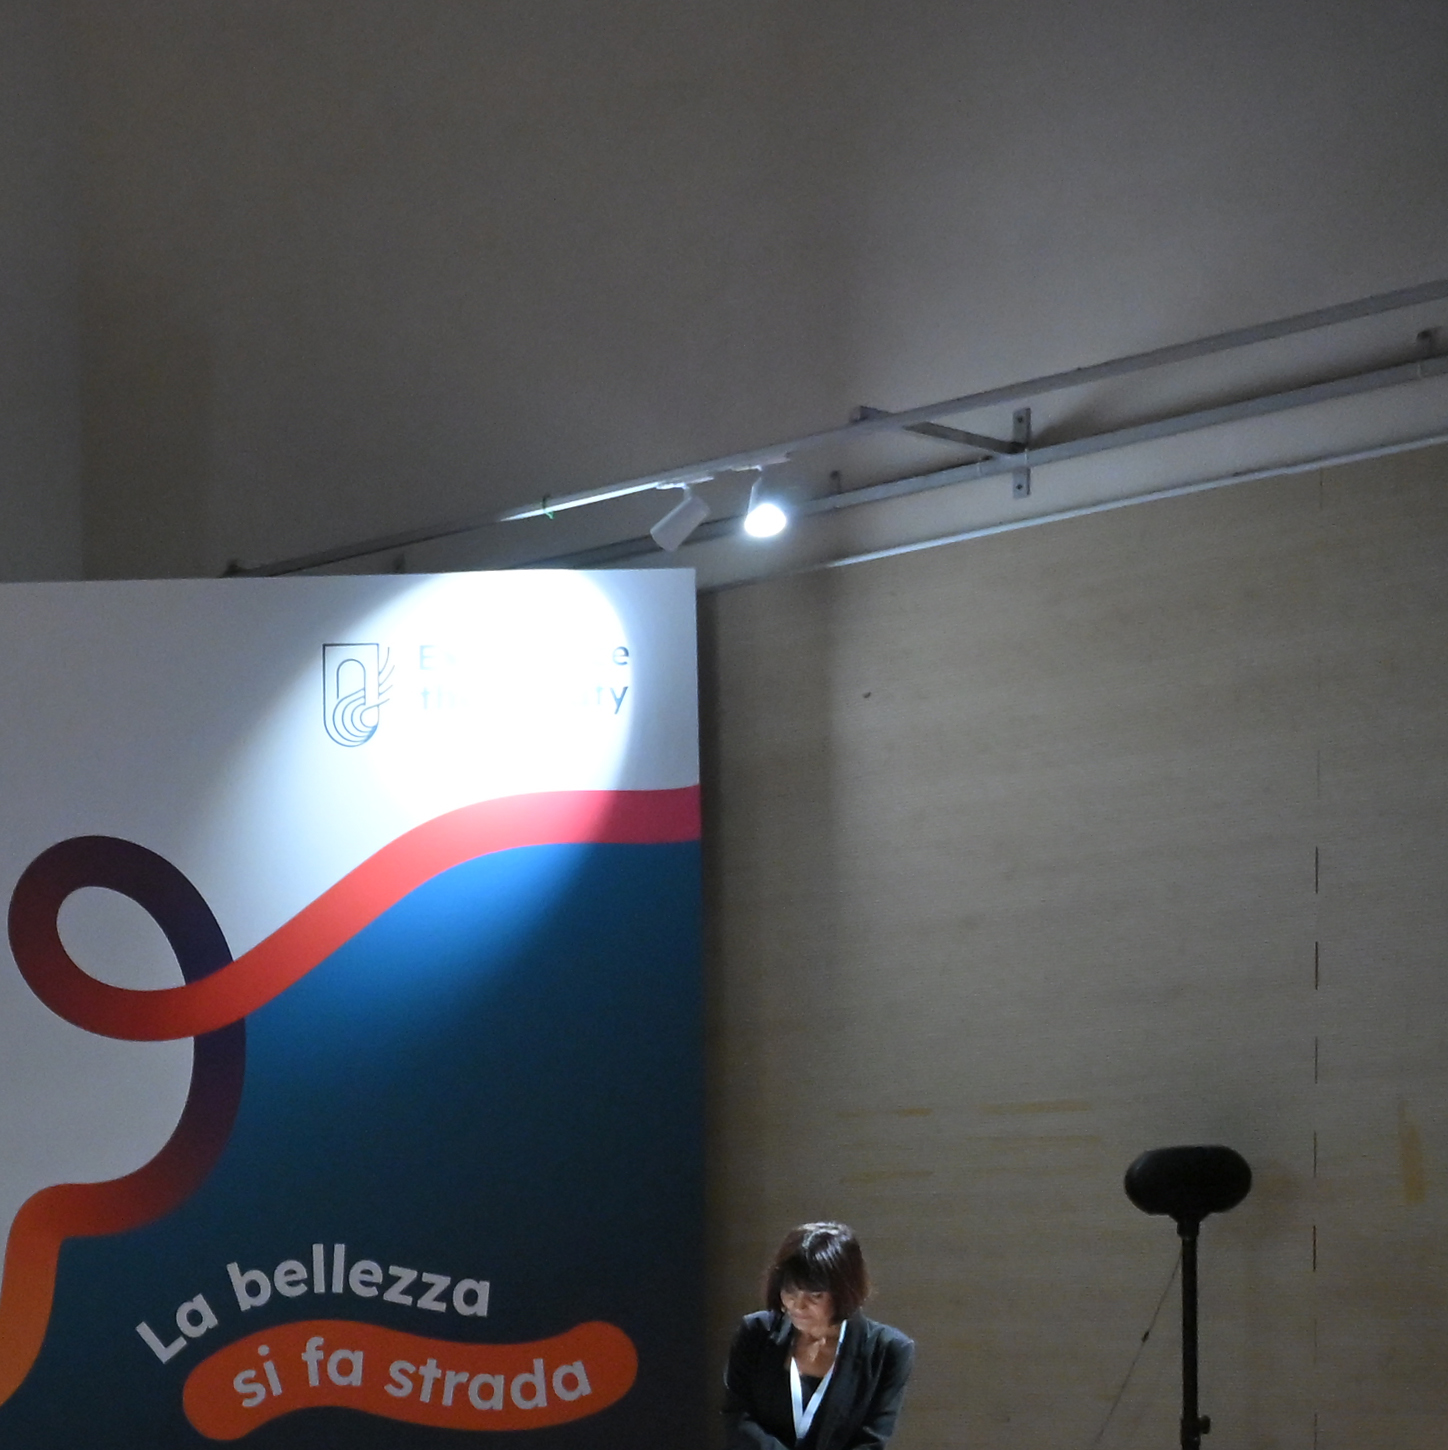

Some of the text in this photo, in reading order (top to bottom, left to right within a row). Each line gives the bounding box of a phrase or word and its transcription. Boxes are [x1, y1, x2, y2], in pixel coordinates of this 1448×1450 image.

[135, 1242, 491, 1364] La bellezza
[232, 1336, 592, 1411] si fa strada
